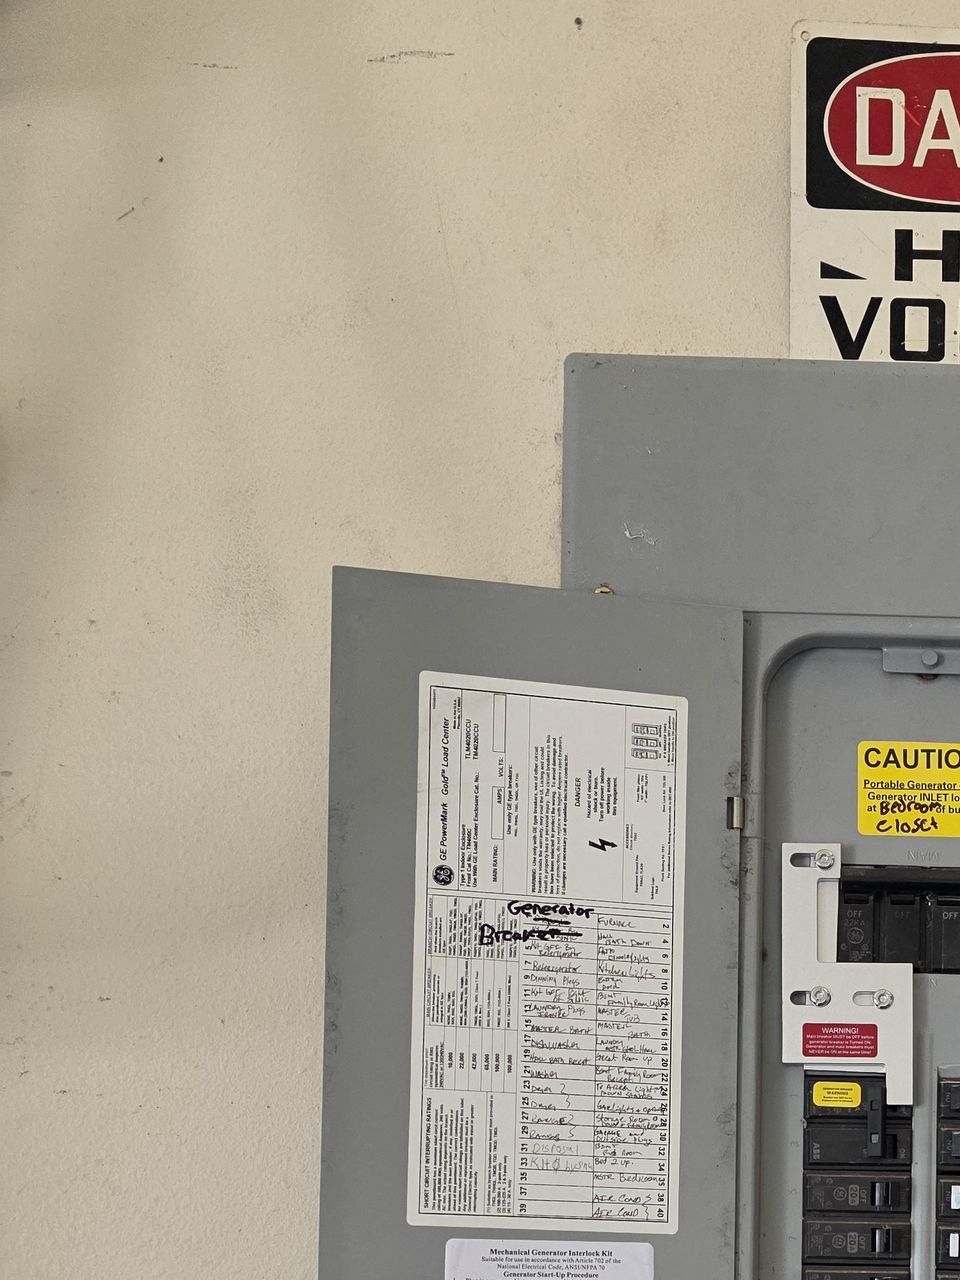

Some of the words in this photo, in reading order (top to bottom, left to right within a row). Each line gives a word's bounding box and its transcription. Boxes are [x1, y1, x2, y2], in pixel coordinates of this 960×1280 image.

[441, 717, 449, 745] Center
[441, 746, 449, 767] Load
[863, 779, 905, 790] Portable
[907, 780, 957, 790] Generator
[867, 792, 917, 801] Generator
[920, 793, 949, 802] INLET
[439, 802, 448, 847] PowerMark
[439, 848, 447, 861] GE
[507, 900, 595, 919] Generator
[846, 910, 863, 918] OFF
[942, 912, 959, 920] OFF
[521, 1111, 529, 1121] 27
[520, 1143, 528, 1152] 31
[520, 1157, 528, 1167] 33
[520, 1171, 527, 1181] 35
[520, 1187, 527, 1196] 37
[848, 1185, 859, 1206] 20A
[657, 1193, 665, 1202] 38
[519, 1204, 527, 1213] 39
[657, 1208, 664, 1218] 40
[490, 1248, 530, 1256] Mechanical
